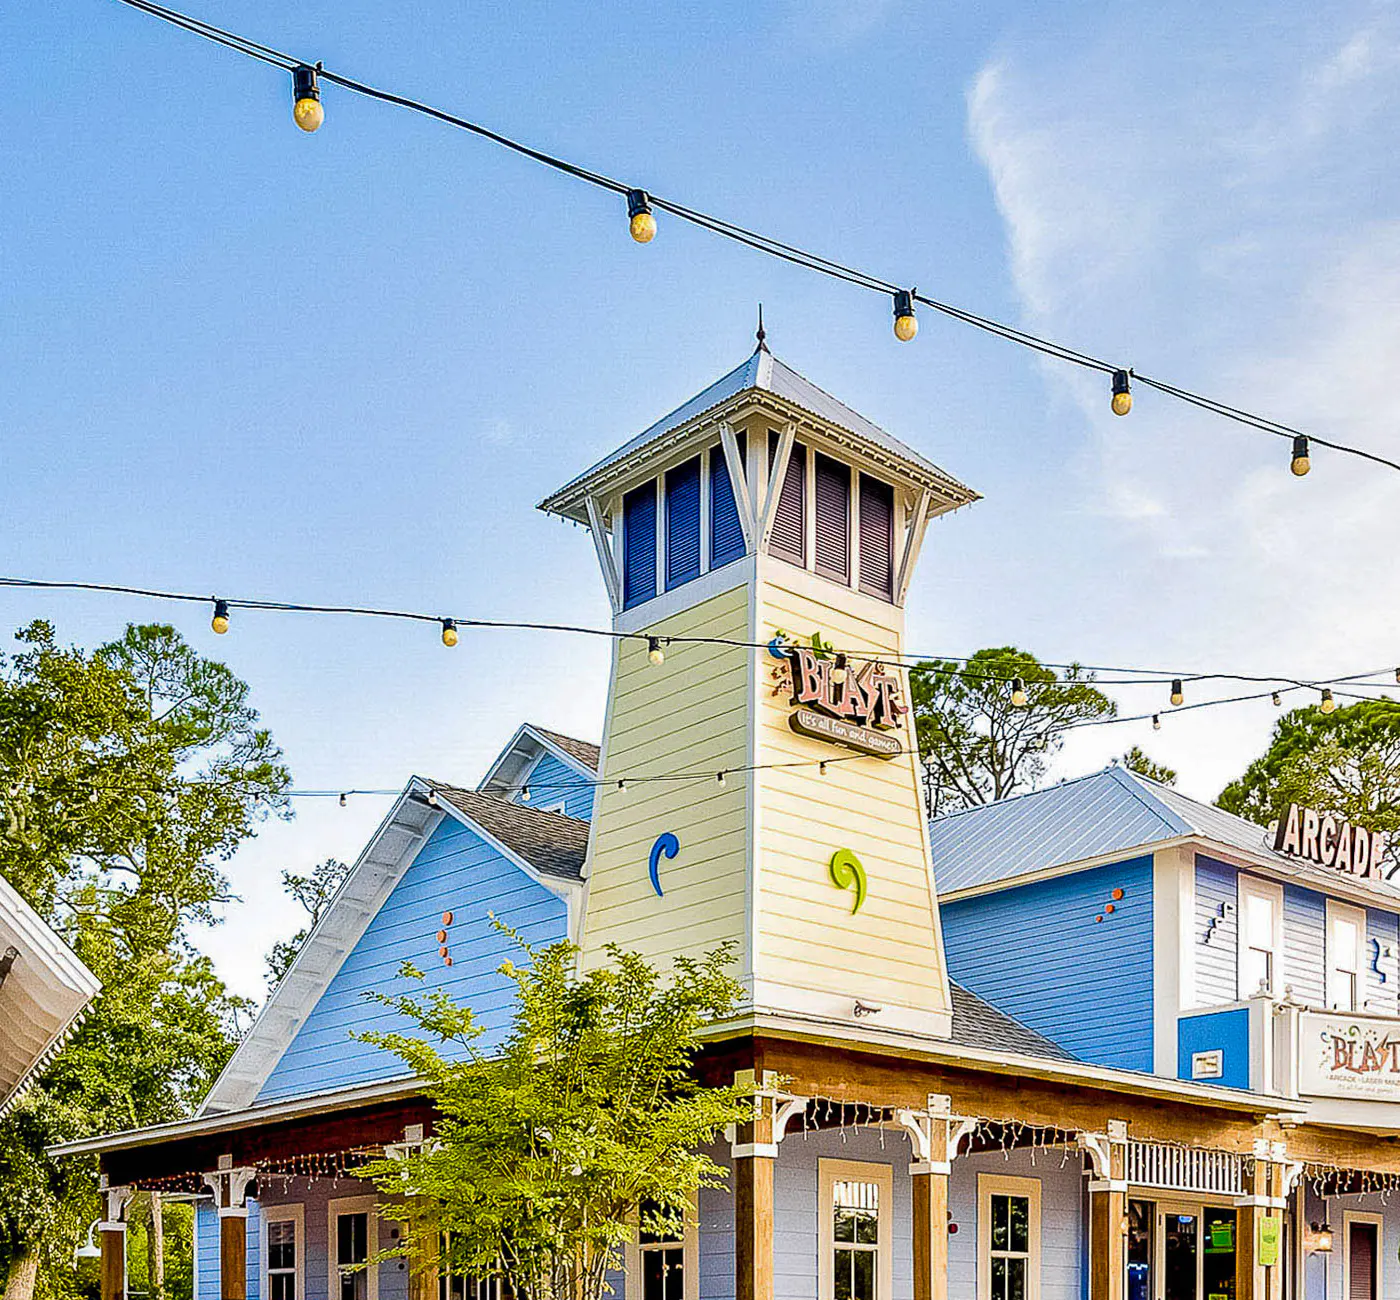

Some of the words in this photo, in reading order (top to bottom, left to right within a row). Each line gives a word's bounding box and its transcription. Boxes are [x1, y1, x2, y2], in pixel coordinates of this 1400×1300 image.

[798, 649, 900, 729] BLAST
[832, 722, 847, 736] fun
[1281, 803, 1385, 880] ARCADE
